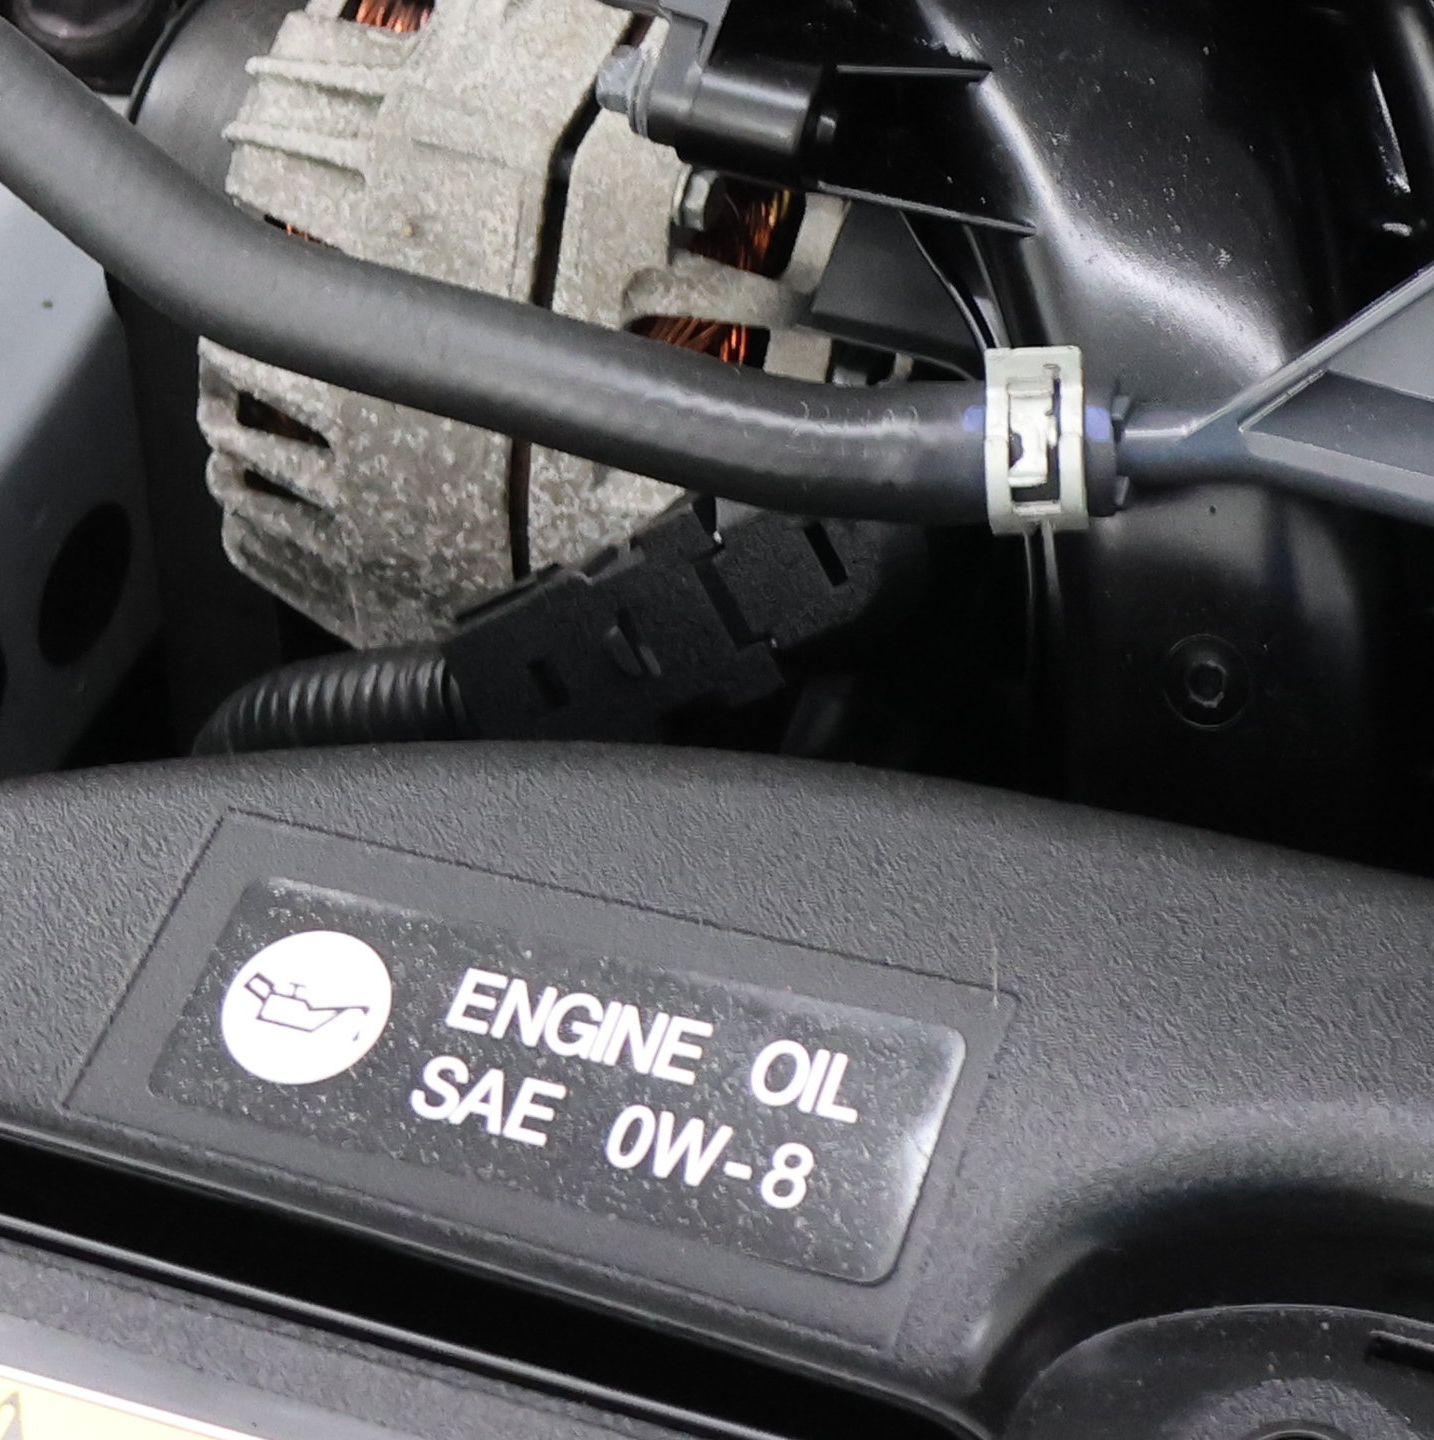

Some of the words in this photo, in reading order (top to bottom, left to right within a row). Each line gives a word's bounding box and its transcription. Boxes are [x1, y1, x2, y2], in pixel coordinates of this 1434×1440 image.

[445, 966, 716, 1085] ENGINE
[750, 1038, 860, 1124] OIL
[410, 1056, 566, 1145] SAE
[606, 1103, 815, 1211] 0W-8
